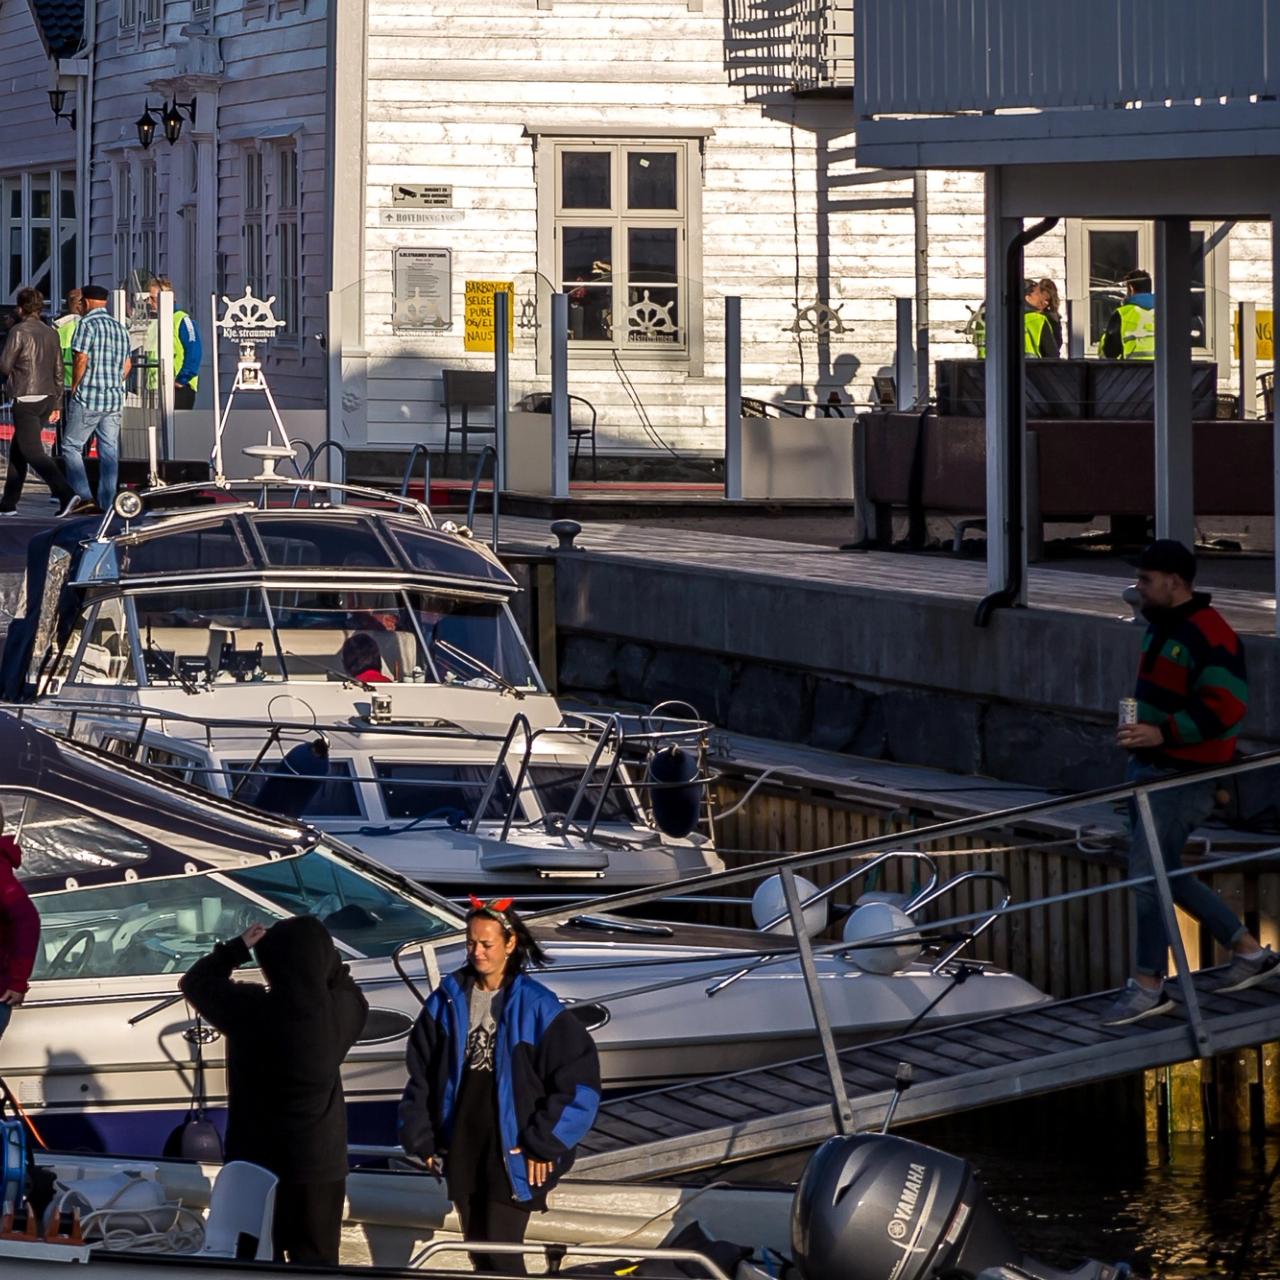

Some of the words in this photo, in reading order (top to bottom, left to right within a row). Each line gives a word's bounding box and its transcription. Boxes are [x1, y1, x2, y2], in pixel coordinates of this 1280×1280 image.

[467, 296, 494, 306] SELGE
[470, 307, 493, 318] PUBE
[223, 327, 276, 339] Kjestraumen
[467, 330, 494, 342] NAUS
[893, 1163, 926, 1220] YAMAHA
